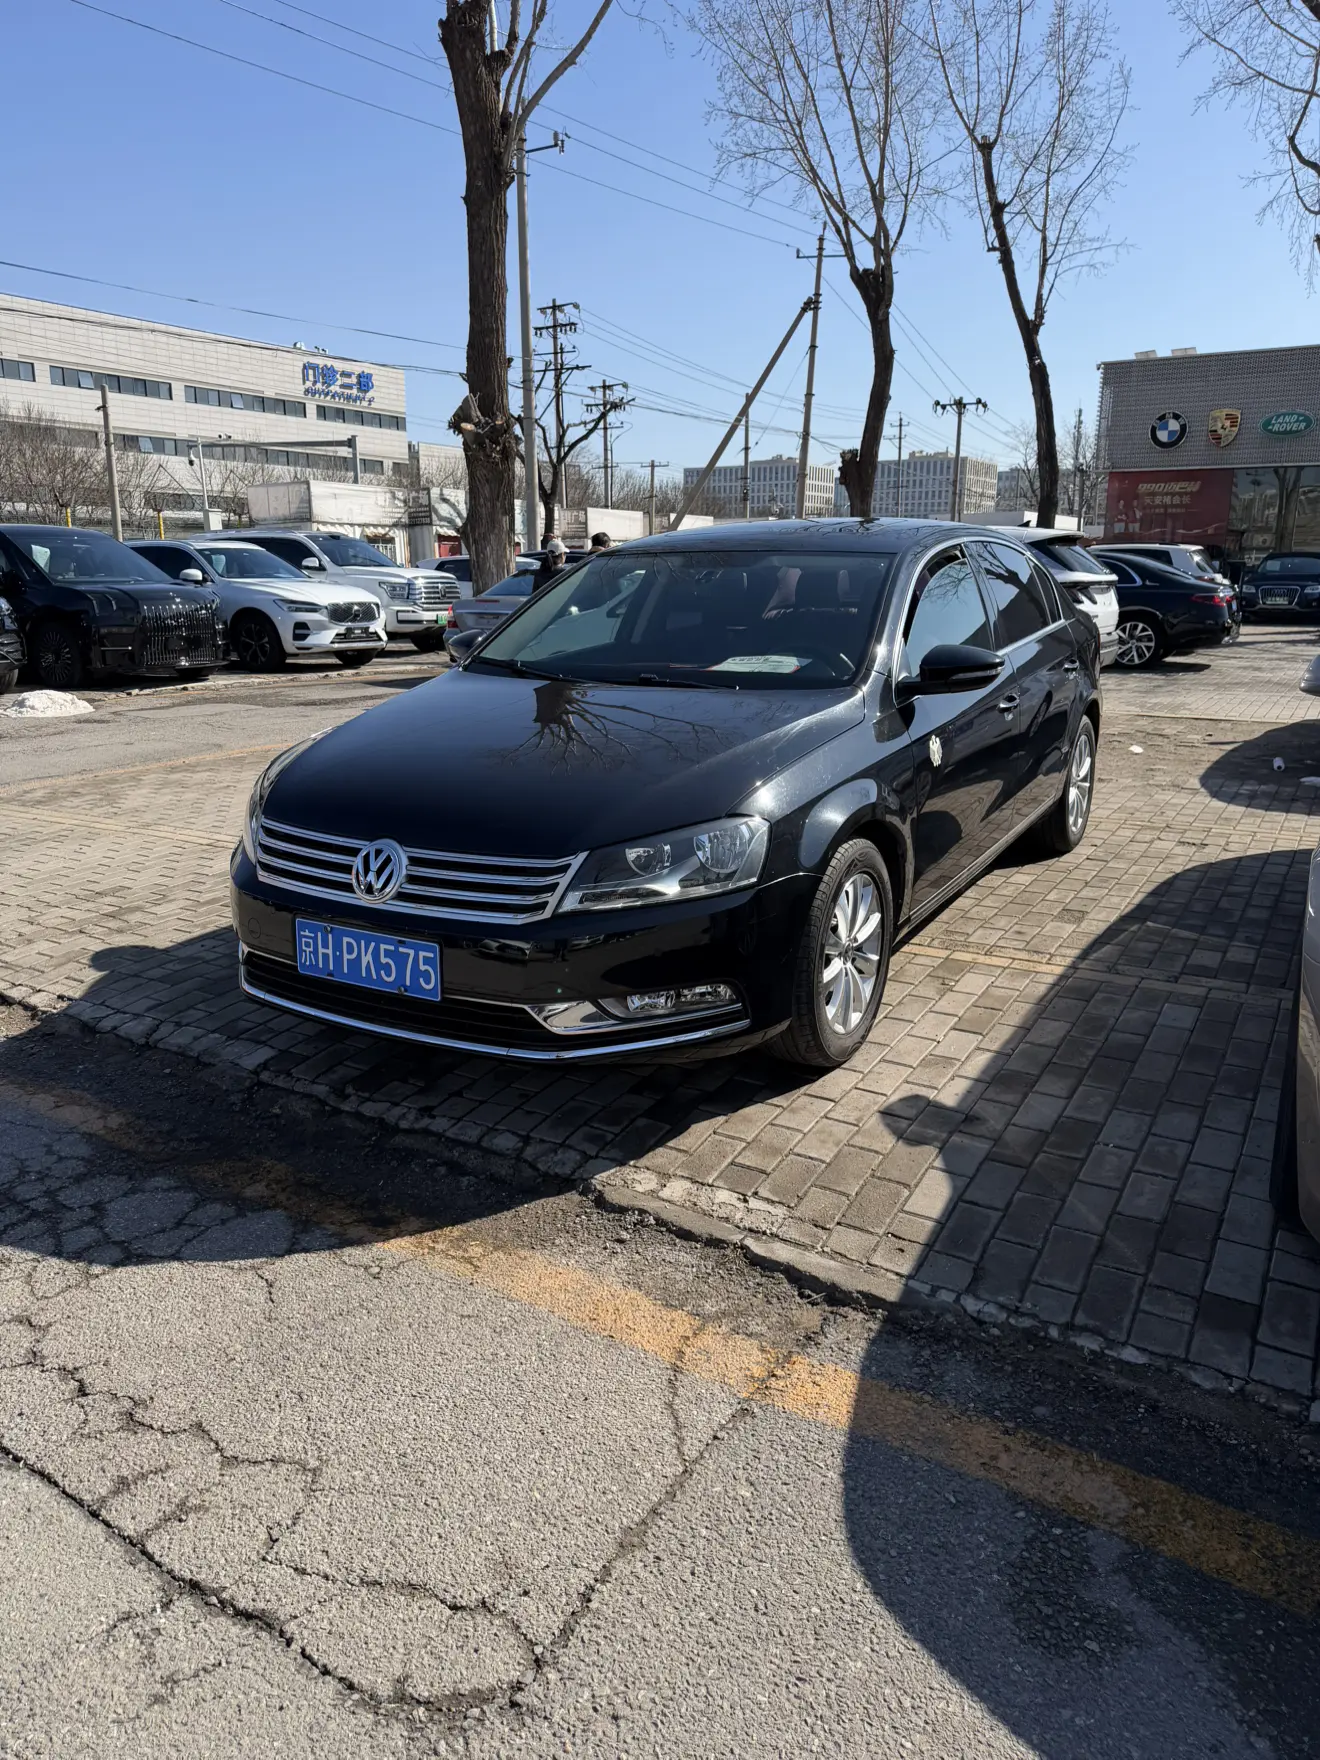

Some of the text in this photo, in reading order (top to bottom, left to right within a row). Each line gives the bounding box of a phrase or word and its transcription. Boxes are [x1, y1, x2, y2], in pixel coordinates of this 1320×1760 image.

[303, 361, 375, 391] 门诊二部
[1271, 414, 1298, 424] LAND
[1272, 422, 1306, 432] ROVER
